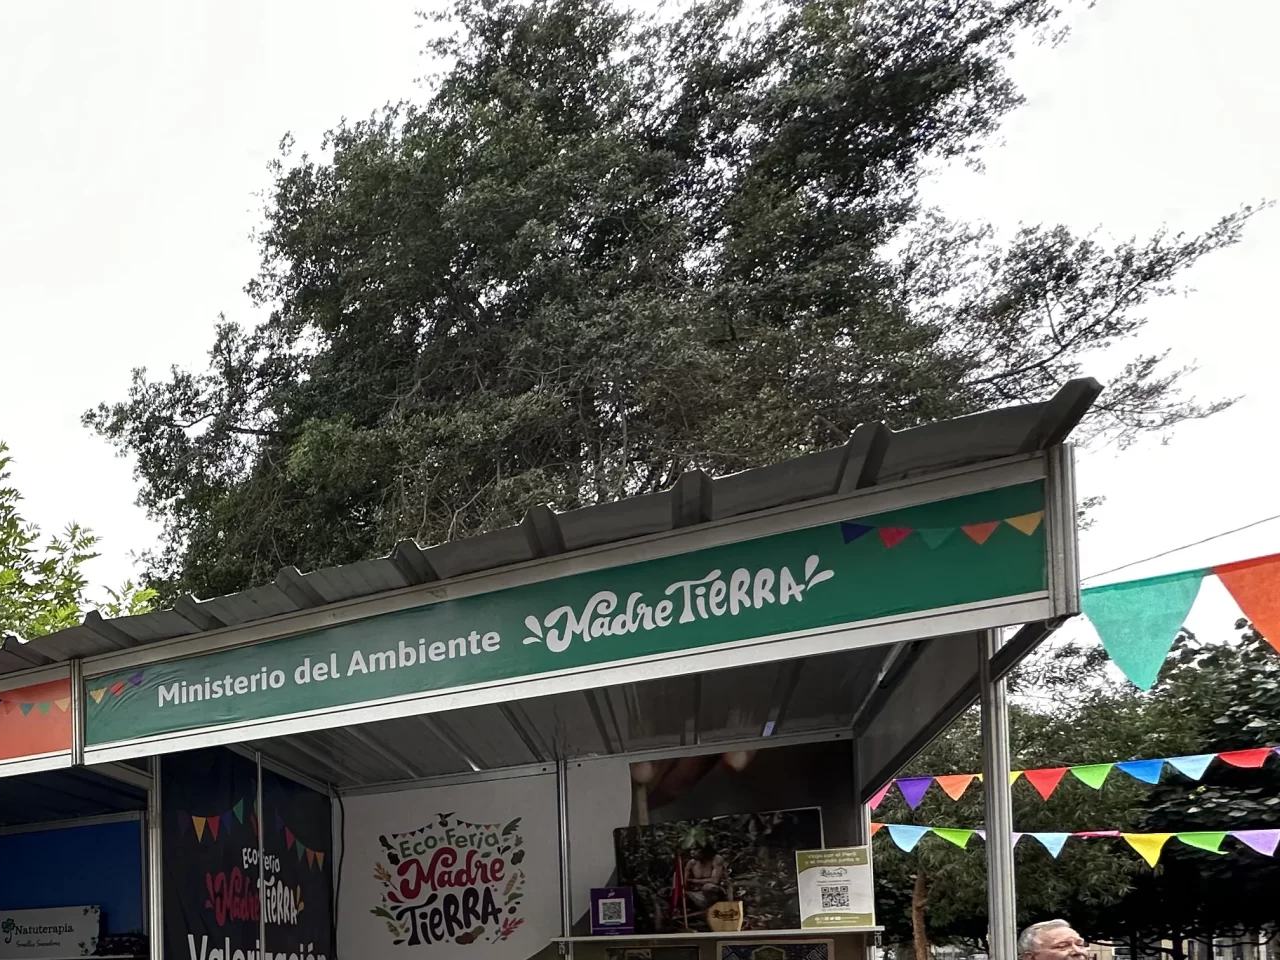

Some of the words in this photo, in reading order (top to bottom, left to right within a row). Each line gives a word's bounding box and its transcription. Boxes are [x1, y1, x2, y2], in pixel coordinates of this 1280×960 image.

[157, 669, 285, 708] Ministerio
[294, 653, 340, 685] del
[347, 630, 501, 677] Ambiente
[544, 590, 673, 653] Madre
[445, 828, 500, 849] Feria
[397, 847, 505, 899] Madre
[14, 923, 74, 935] Natuterapia
